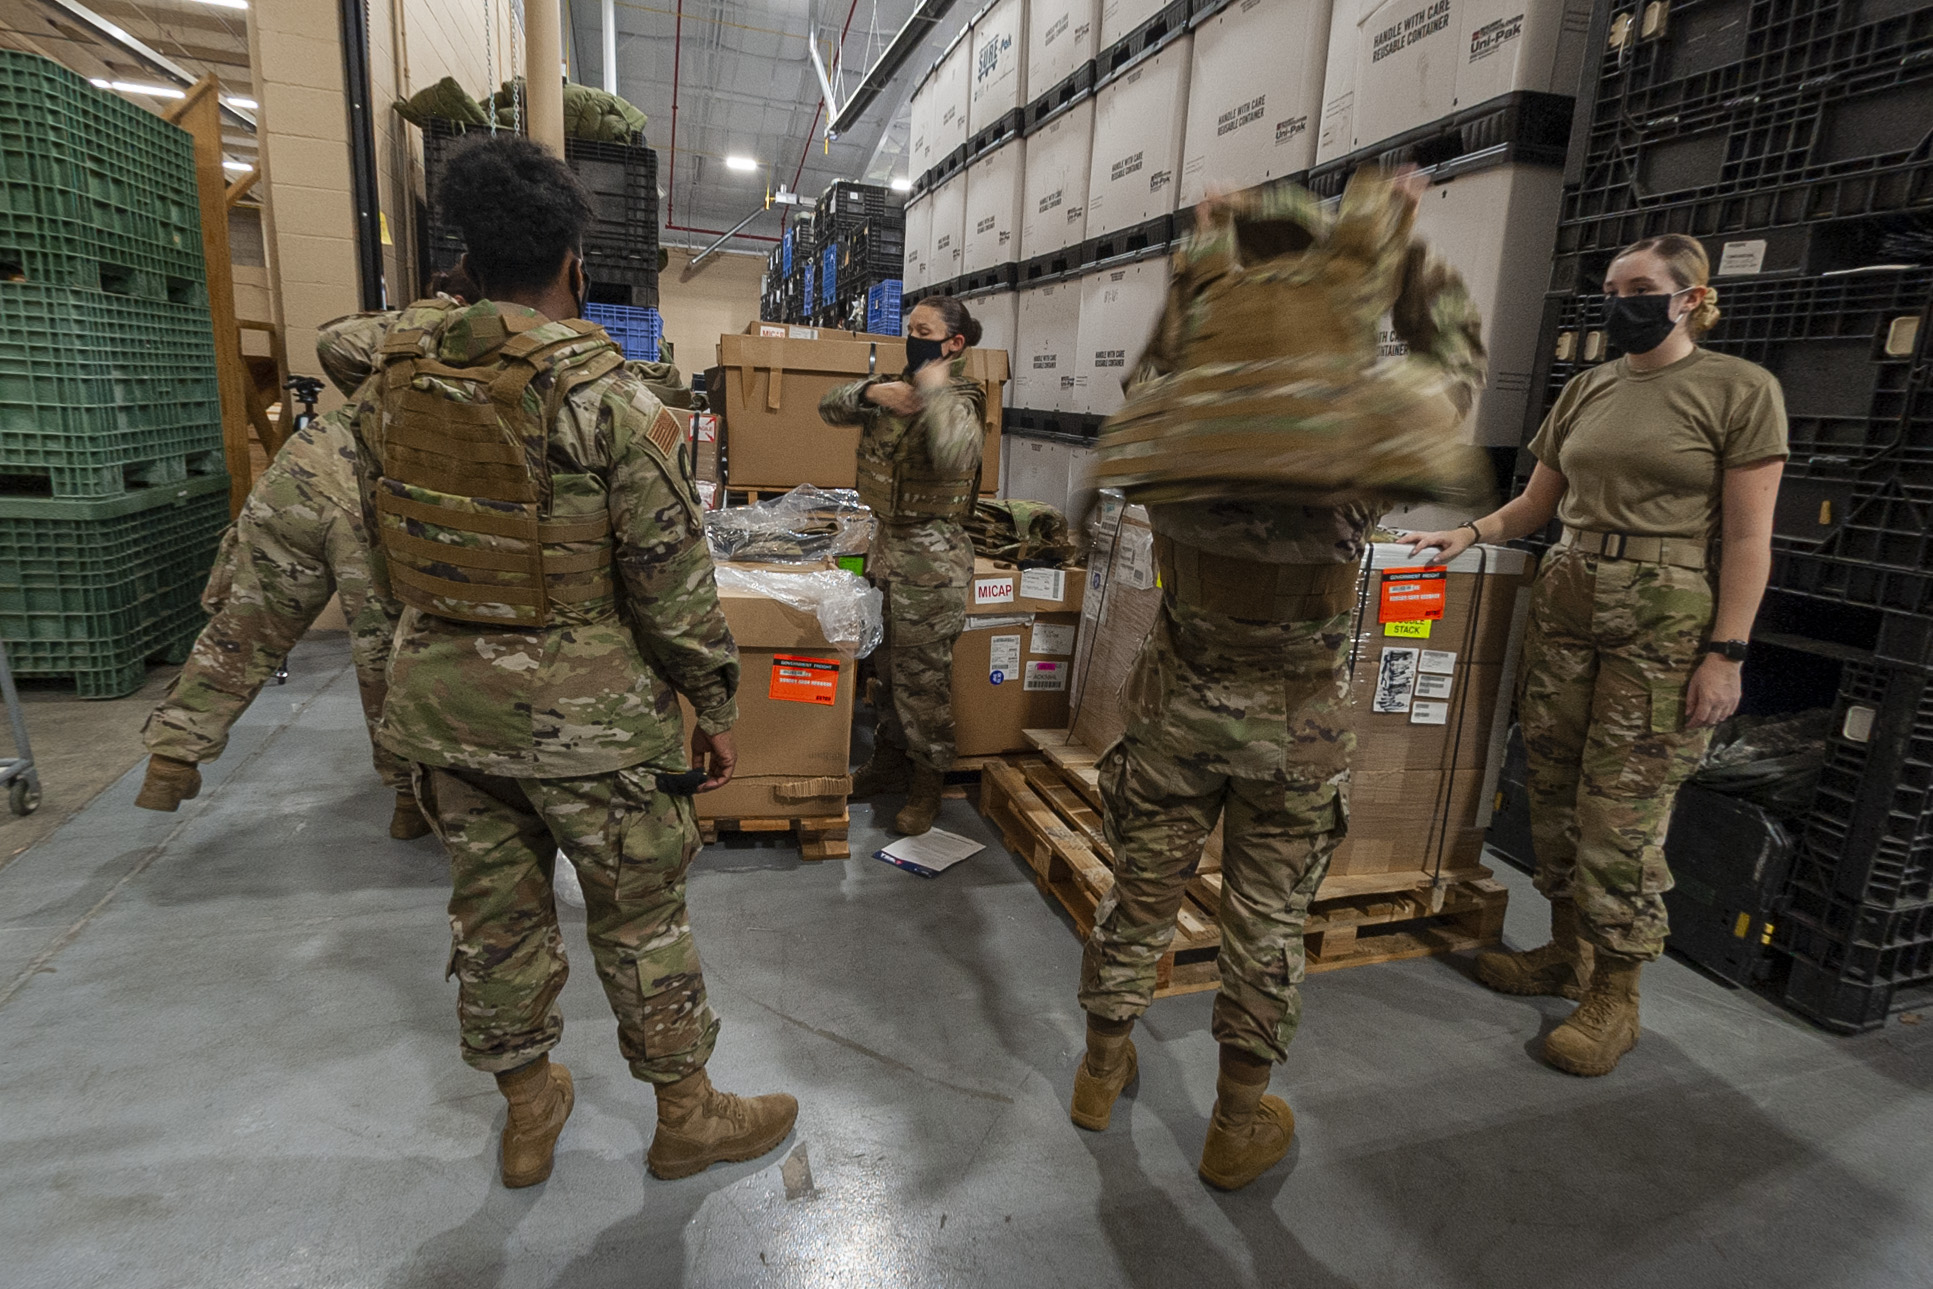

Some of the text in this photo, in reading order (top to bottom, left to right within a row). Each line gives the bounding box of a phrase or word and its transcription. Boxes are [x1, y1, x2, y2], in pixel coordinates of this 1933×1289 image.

[1373, 0, 1450, 49] HANDLE WITH CARE
[1372, 34, 1406, 64] REUSABLE
[1406, 13, 1450, 46] CONTAINER
[1470, 23, 1521, 53] Uni-Pak
[1237, 102, 1251, 116] WITH
[1251, 95, 1265, 110] CARE
[1276, 121, 1306, 140] Uni-Pak
[978, 585, 1012, 598] MICAP
[1394, 625, 1421, 634] STACK
